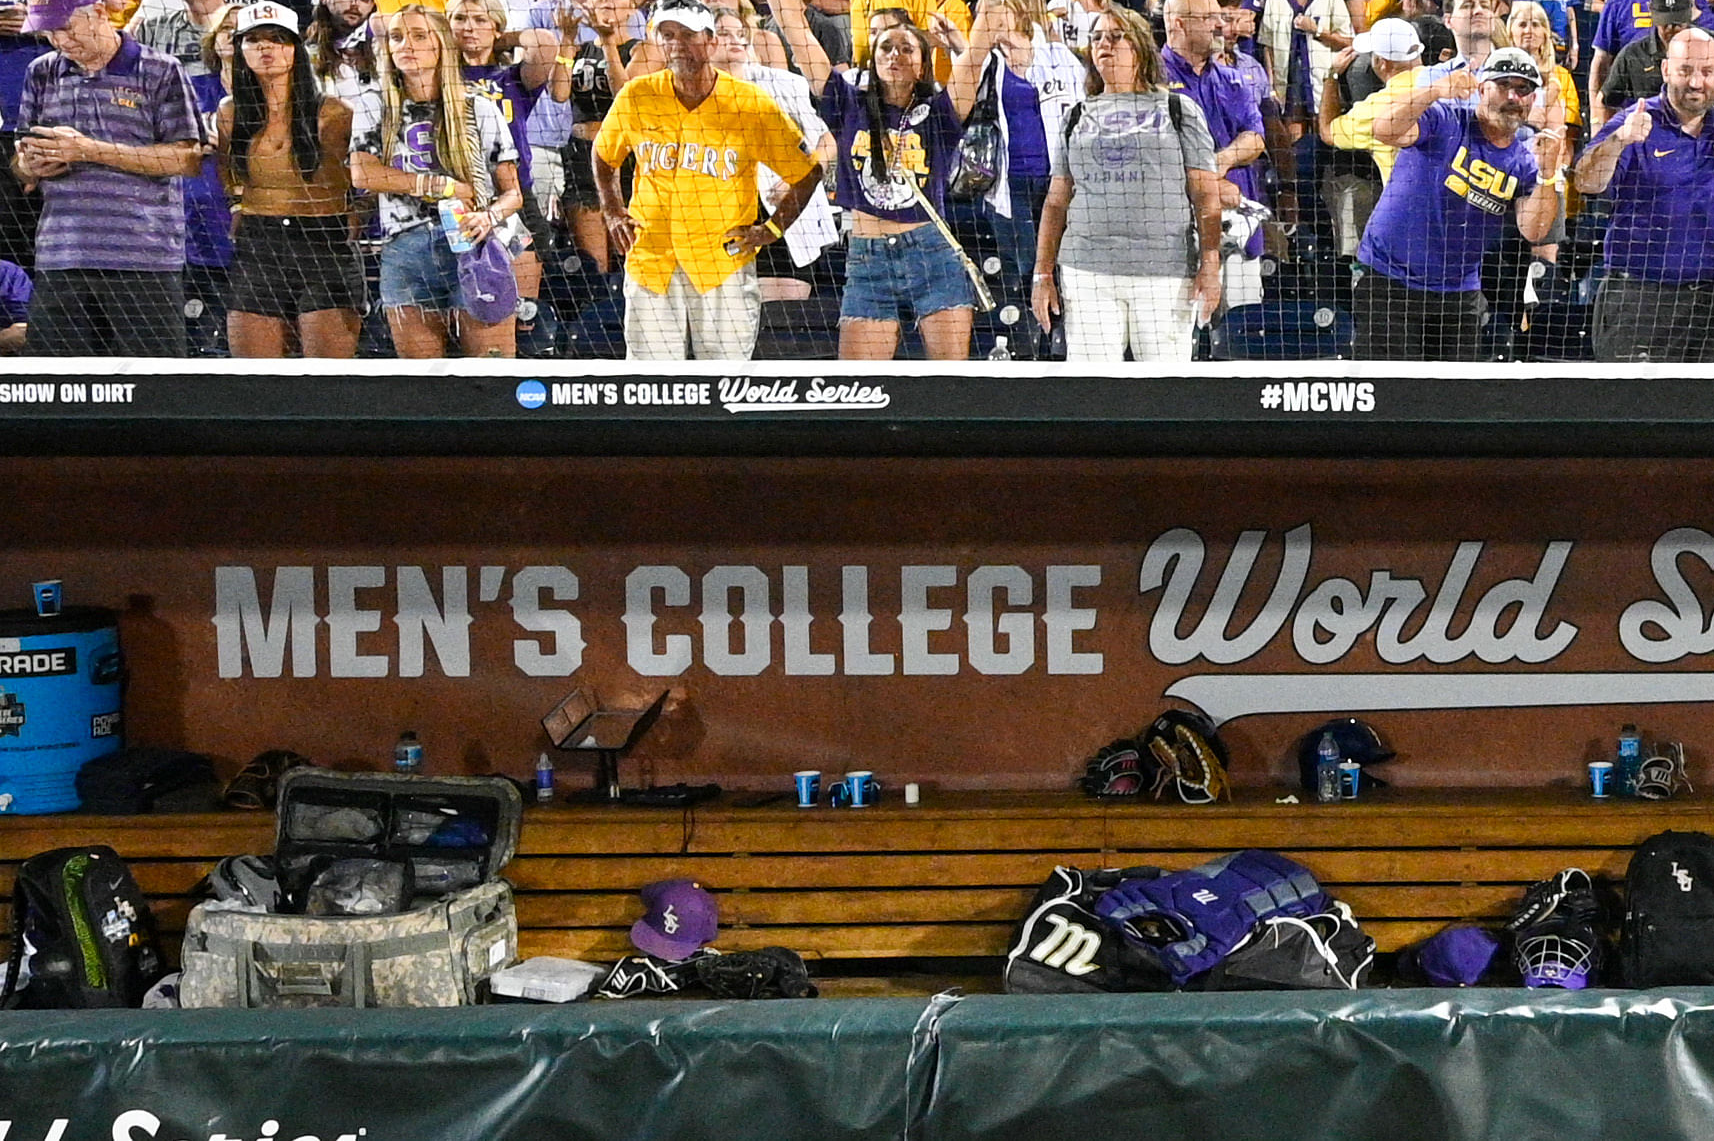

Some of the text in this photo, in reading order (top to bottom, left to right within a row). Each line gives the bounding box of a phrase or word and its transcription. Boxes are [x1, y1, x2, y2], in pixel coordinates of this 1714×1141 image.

[635, 140, 739, 181] TIGERS
[1450, 146, 1518, 201] LSU
[0, 384, 134, 404] SHOW ON DIRT
[552, 378, 890, 406] MEN'S COLLEGE World Series
[1260, 383, 1375, 413] #MCWS
[211, 564, 588, 678] MEN'S
[620, 564, 1105, 677] COLLEGE
[1139, 524, 1579, 666] World
[1671, 861, 1693, 892] LSU
